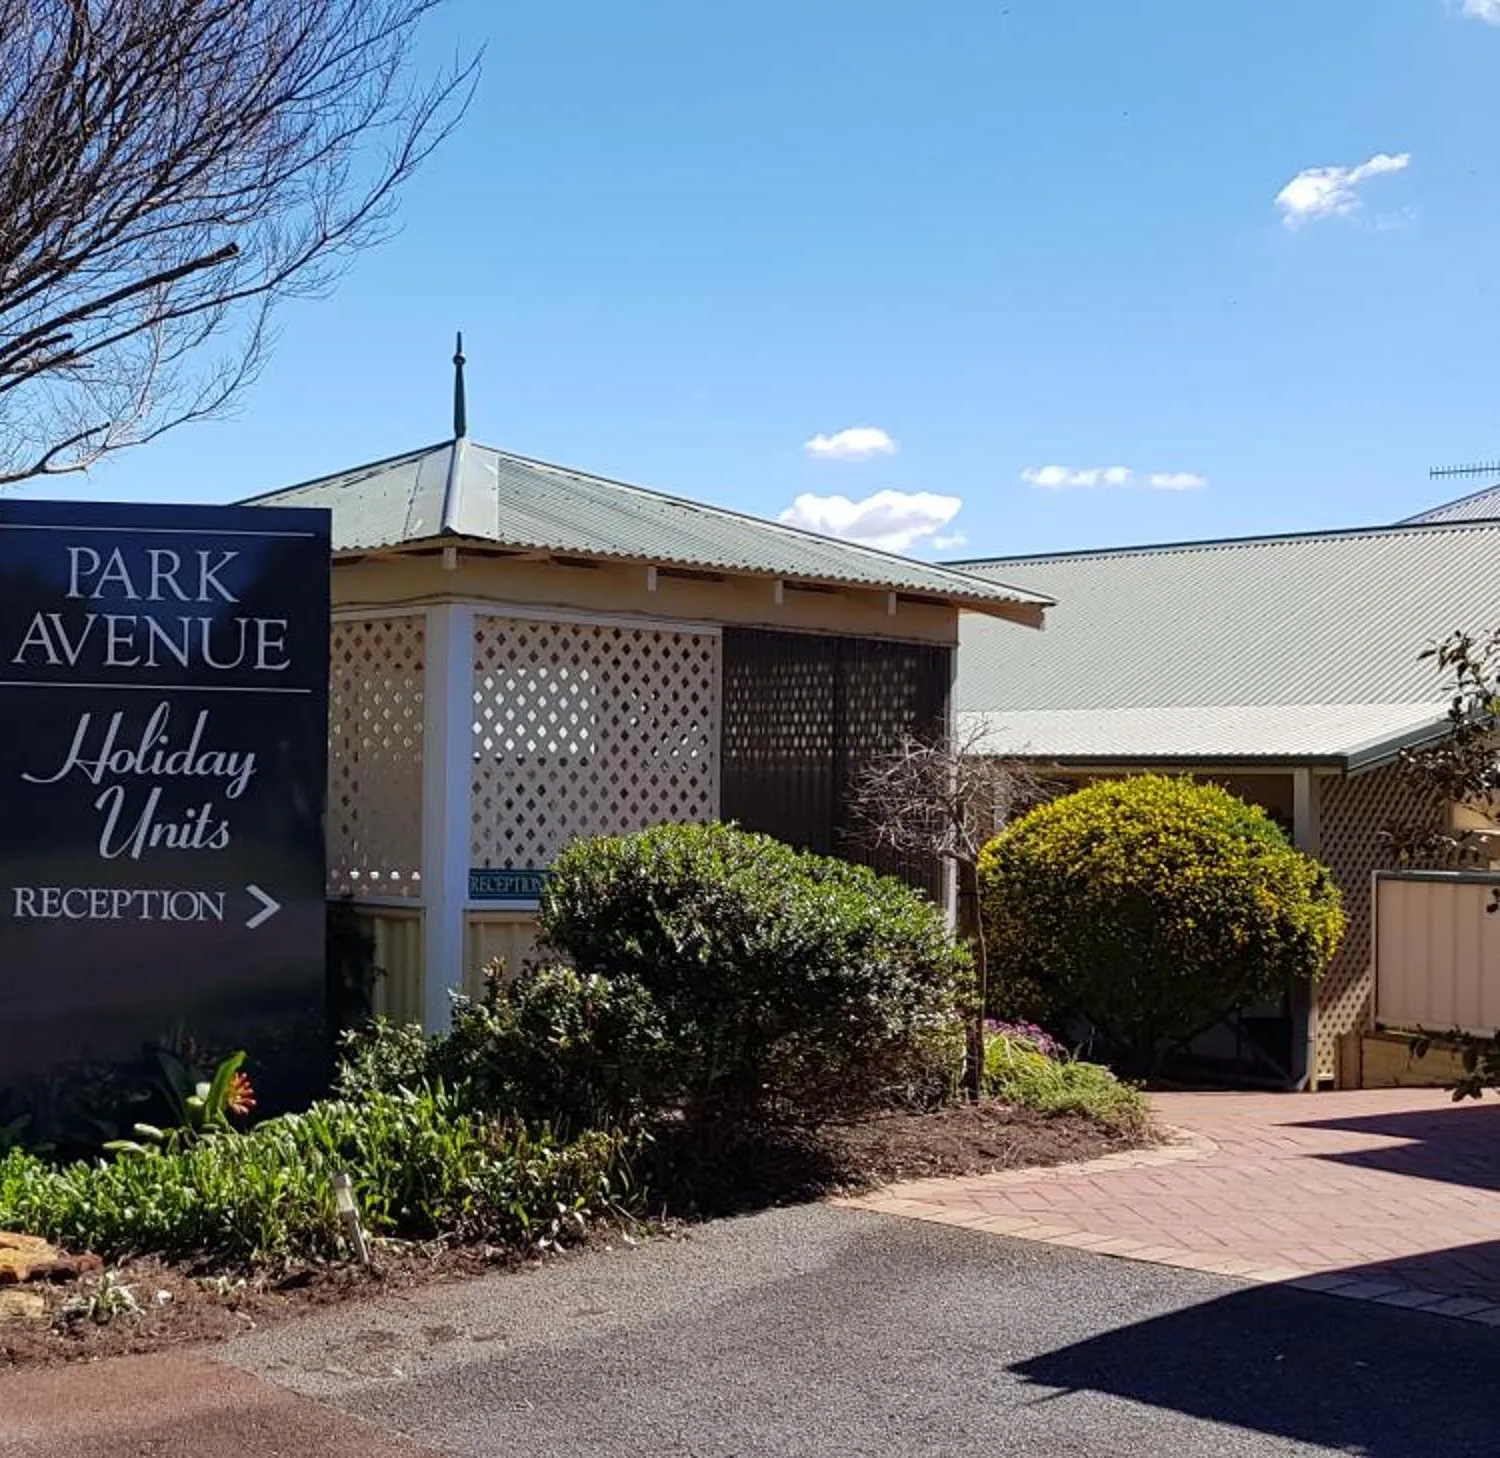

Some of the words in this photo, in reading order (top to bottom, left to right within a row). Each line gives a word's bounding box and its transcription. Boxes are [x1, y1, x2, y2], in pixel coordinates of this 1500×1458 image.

[65, 547, 240, 603] PARK
[11, 611, 291, 671] AVENUE
[21, 700, 257, 799] Holiday
[95, 784, 231, 860] Units
[12, 887, 226, 921] RECEPTION
